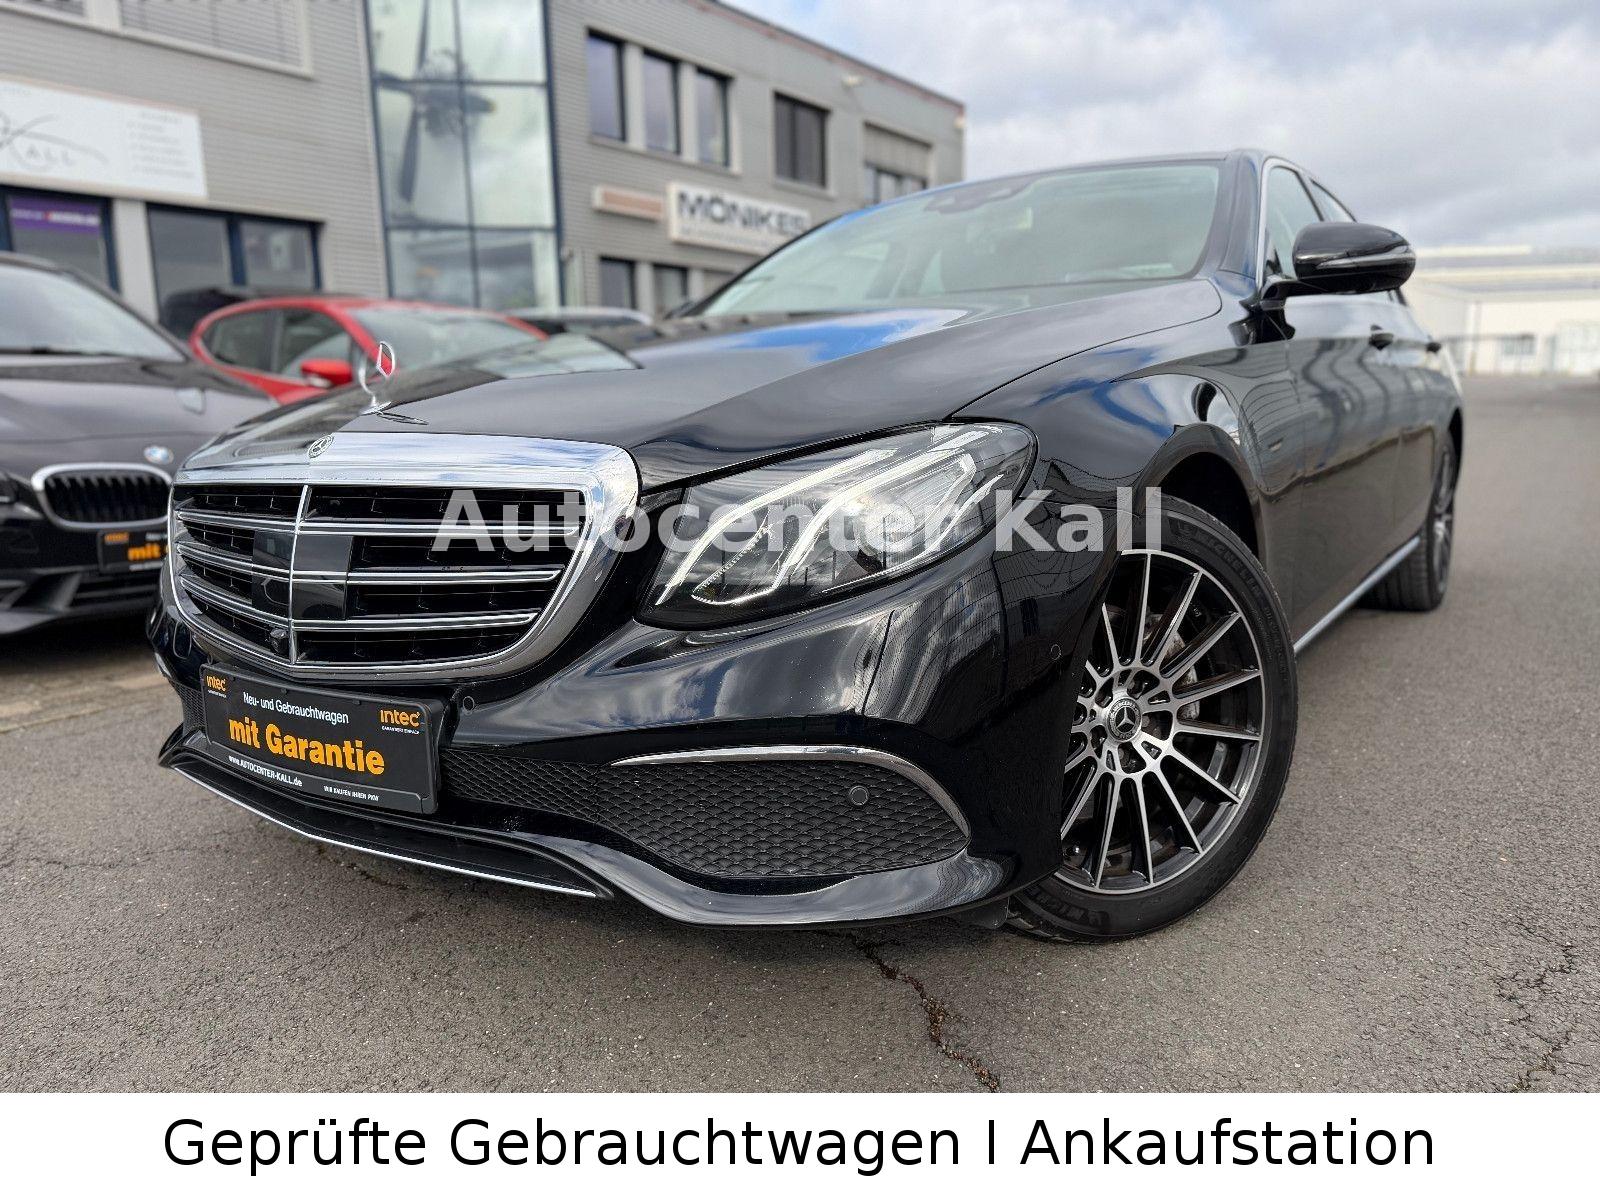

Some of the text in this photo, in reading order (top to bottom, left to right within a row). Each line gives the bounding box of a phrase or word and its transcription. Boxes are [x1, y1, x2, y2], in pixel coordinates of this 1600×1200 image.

[243, 691, 260, 706] Neu-
[260, 698, 275, 711] und
[275, 699, 350, 726] Gebrauchtwagen
[380, 709, 421, 727] intec
[229, 716, 385, 775] mit Garantie
